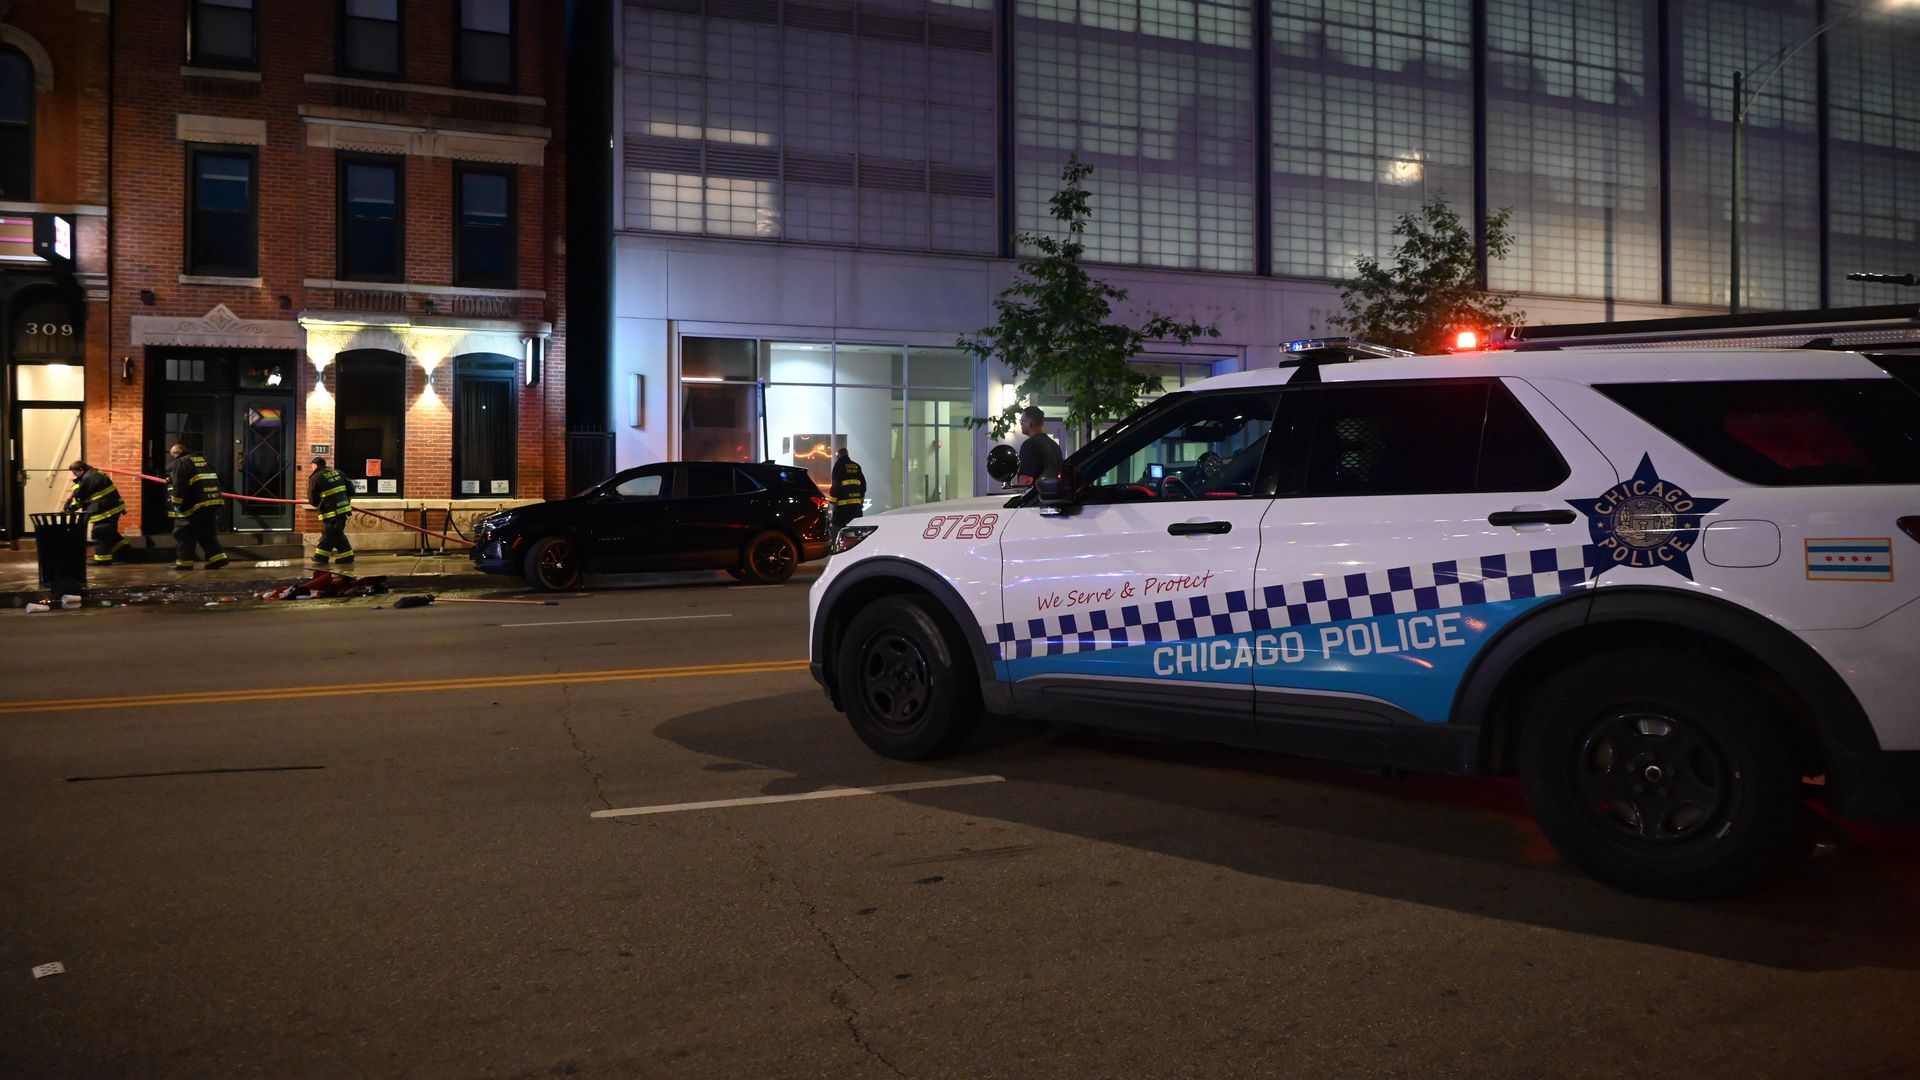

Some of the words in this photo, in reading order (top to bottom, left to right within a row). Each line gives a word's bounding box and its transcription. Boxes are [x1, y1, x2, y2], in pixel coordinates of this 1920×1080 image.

[25, 322, 73, 336] 309
[1594, 480, 1694, 515] CHICAGO
[922, 513, 999, 539] 8728
[1598, 537, 1690, 566] POLICE
[1037, 592, 1064, 611] We
[1067, 588, 1116, 607] Serve
[1120, 581, 1136, 599] &
[1144, 570, 1214, 596] Protect
[1153, 631, 1306, 676] CHICAGO
[1319, 612, 1465, 660] POLICE
